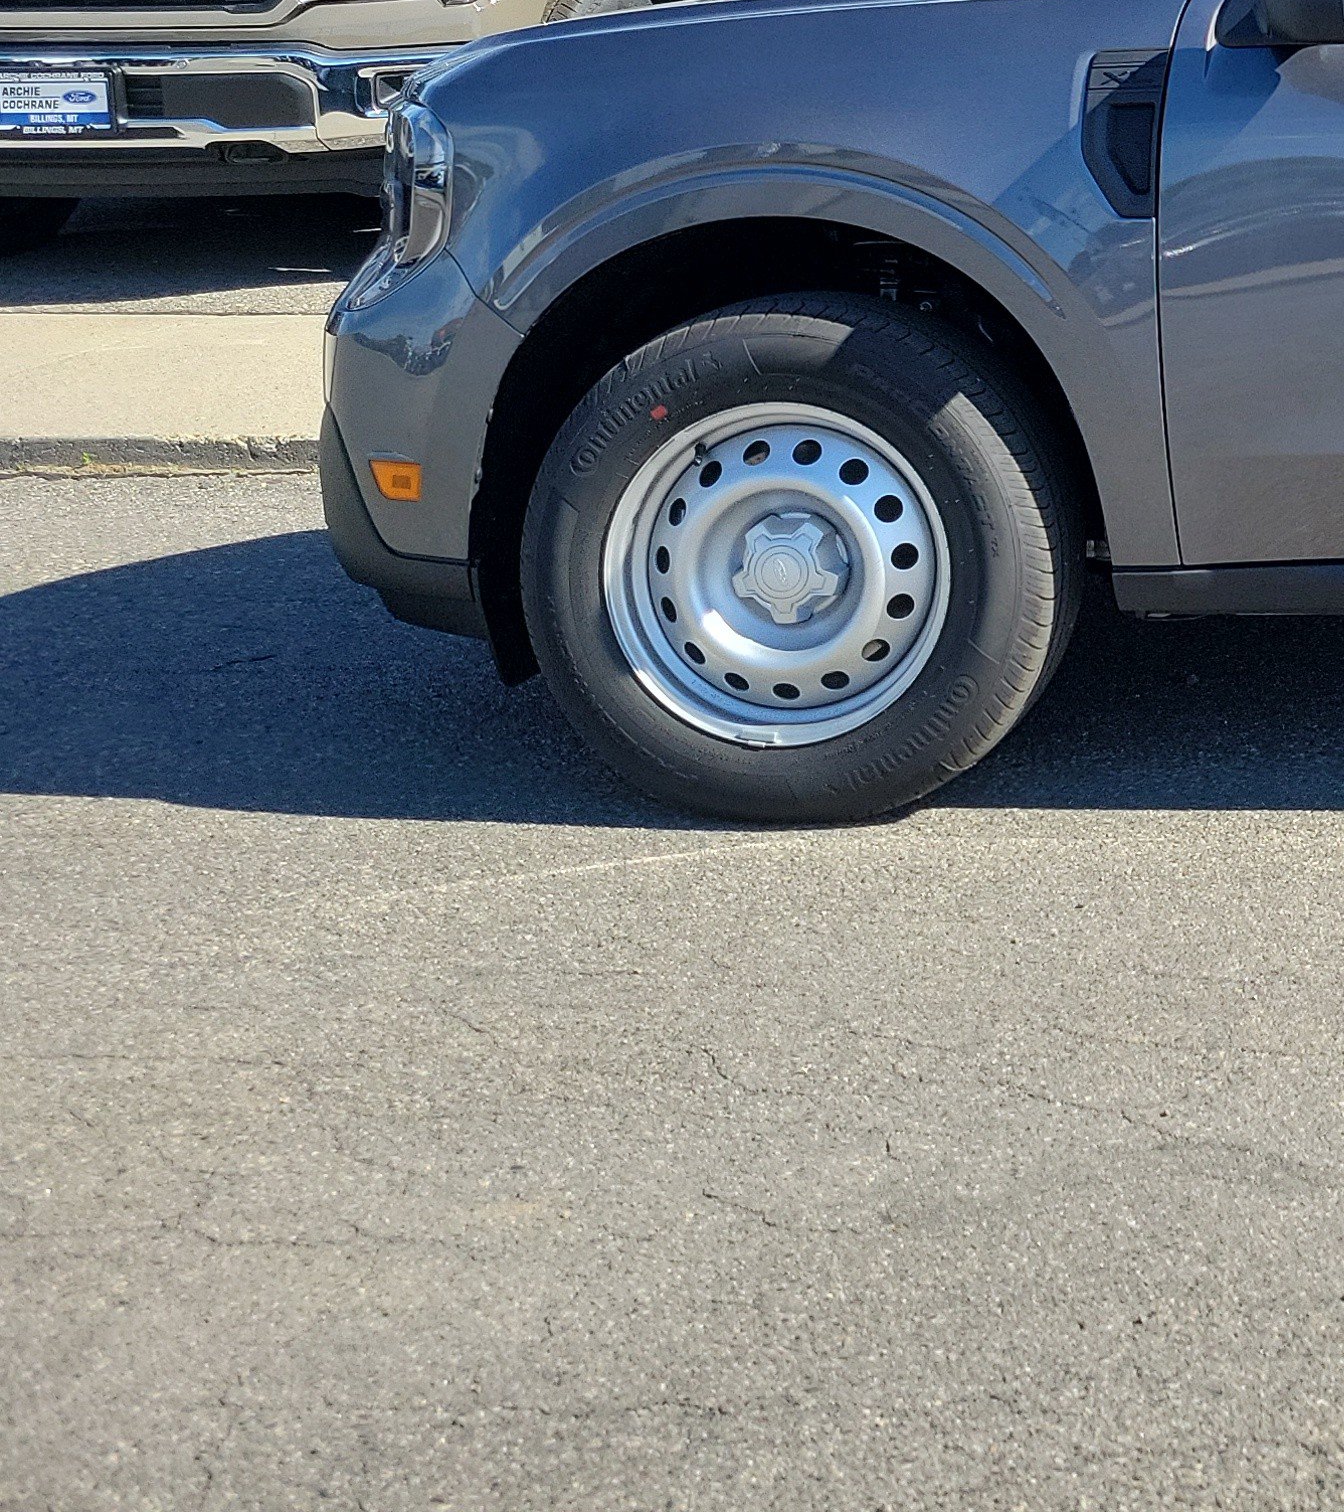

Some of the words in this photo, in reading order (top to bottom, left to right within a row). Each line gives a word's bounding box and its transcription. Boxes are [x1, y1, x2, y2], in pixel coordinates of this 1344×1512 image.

[1, 87, 41, 97] ARCHIE
[2, 100, 60, 110] COCHRANE
[66, 114, 79, 124] MT
[569, 358, 701, 477] Continental
